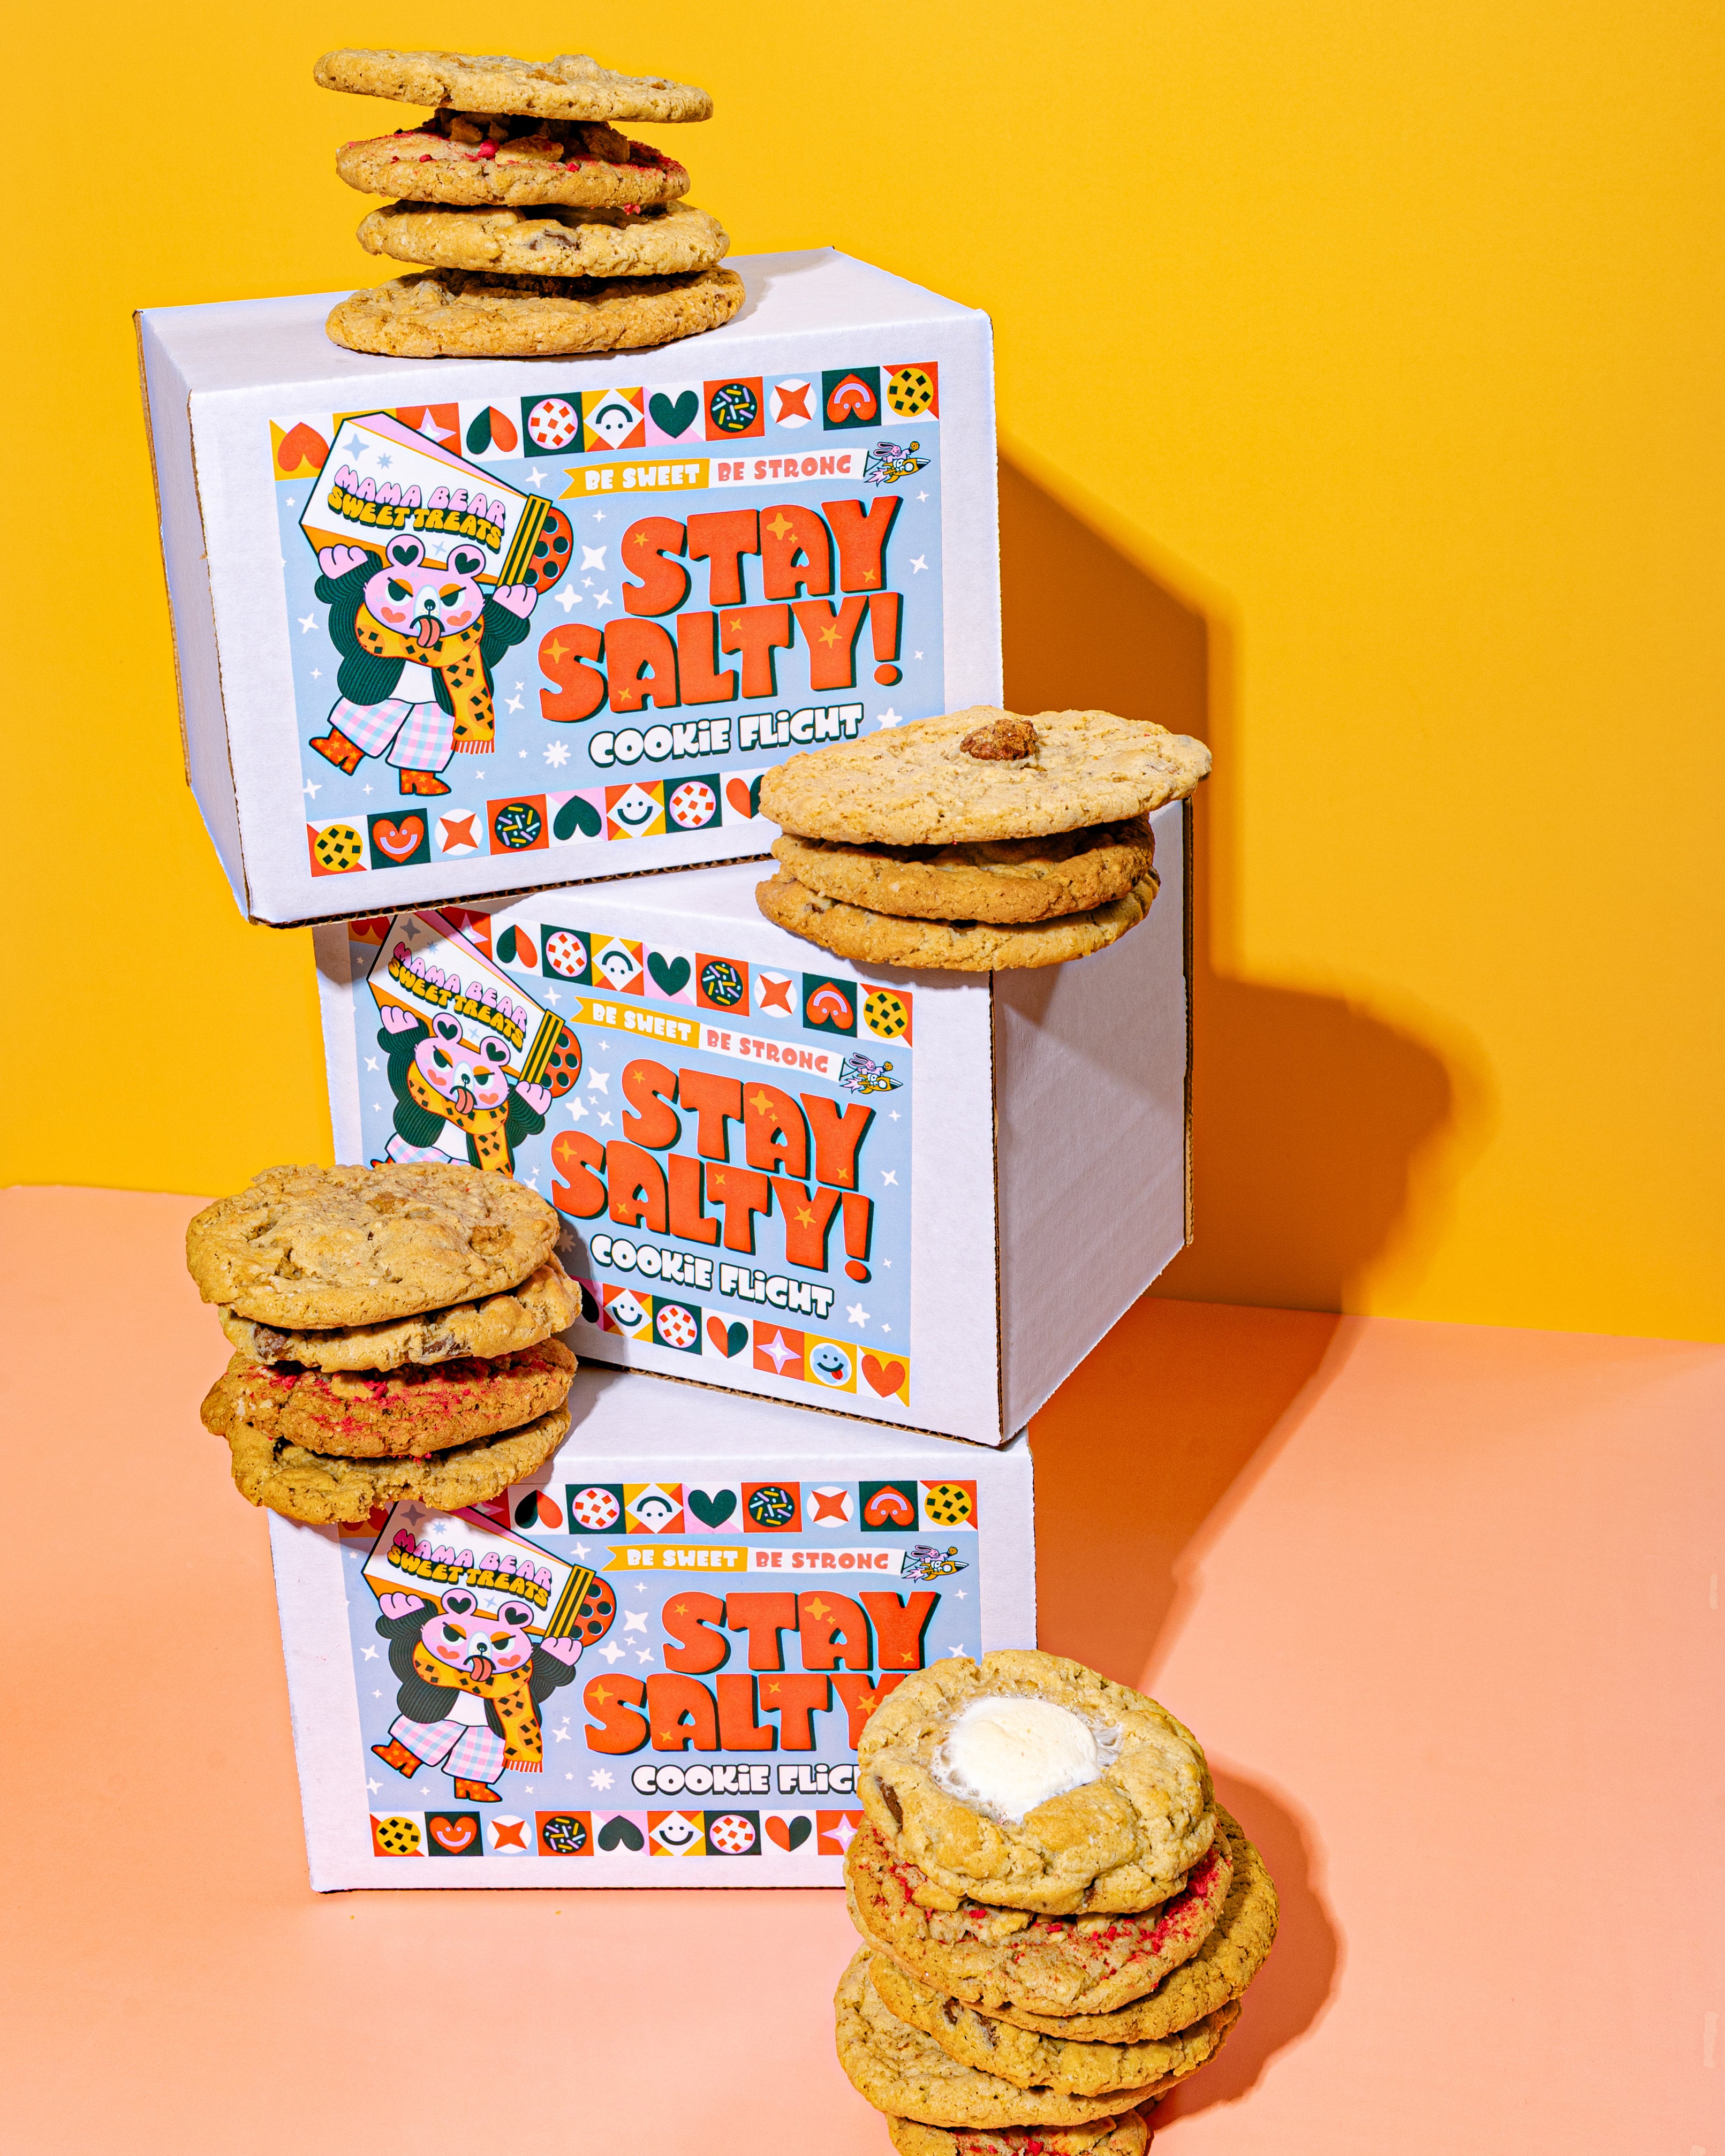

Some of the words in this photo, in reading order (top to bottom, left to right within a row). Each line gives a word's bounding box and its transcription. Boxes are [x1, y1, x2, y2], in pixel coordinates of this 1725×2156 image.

[335, 465, 422, 508] MAMA
[428, 486, 506, 530] BEAR
[585, 470, 614, 490] BE
[623, 465, 699, 487] SWEET
[718, 462, 745, 481] BE
[754, 456, 851, 479] STRONG
[328, 486, 411, 530] SWEET
[412, 507, 502, 555] TREATS
[621, 496, 903, 617] STAY
[538, 592, 903, 723] SALTY!
[388, 958, 452, 1009] SWEET
[453, 996, 524, 1052] TREATS
[394, 942, 461, 995] MAMA
[465, 981, 527, 1030] BEAR
[593, 1004, 617, 1024] BE
[624, 1012, 691, 1041] SWEET
[707, 1029, 731, 1051] BE
[739, 1038, 828, 1073] STRONG
[622, 1059, 876, 1190] STAY
[550, 1130, 874, 1284] SALTY!
[388, 1545, 464, 1585] SWEET
[465, 1568, 549, 1611] TREATS
[393, 1529, 474, 1568] MAMA
[479, 1552, 552, 1591] BEAR
[627, 1550, 654, 1566] BE
[662, 1549, 739, 1567] SWEET
[756, 1552, 782, 1568] BE
[791, 1552, 889, 1569] STRONG
[662, 1591, 941, 1672] STAY
[583, 1673, 912, 1755] SALTY
